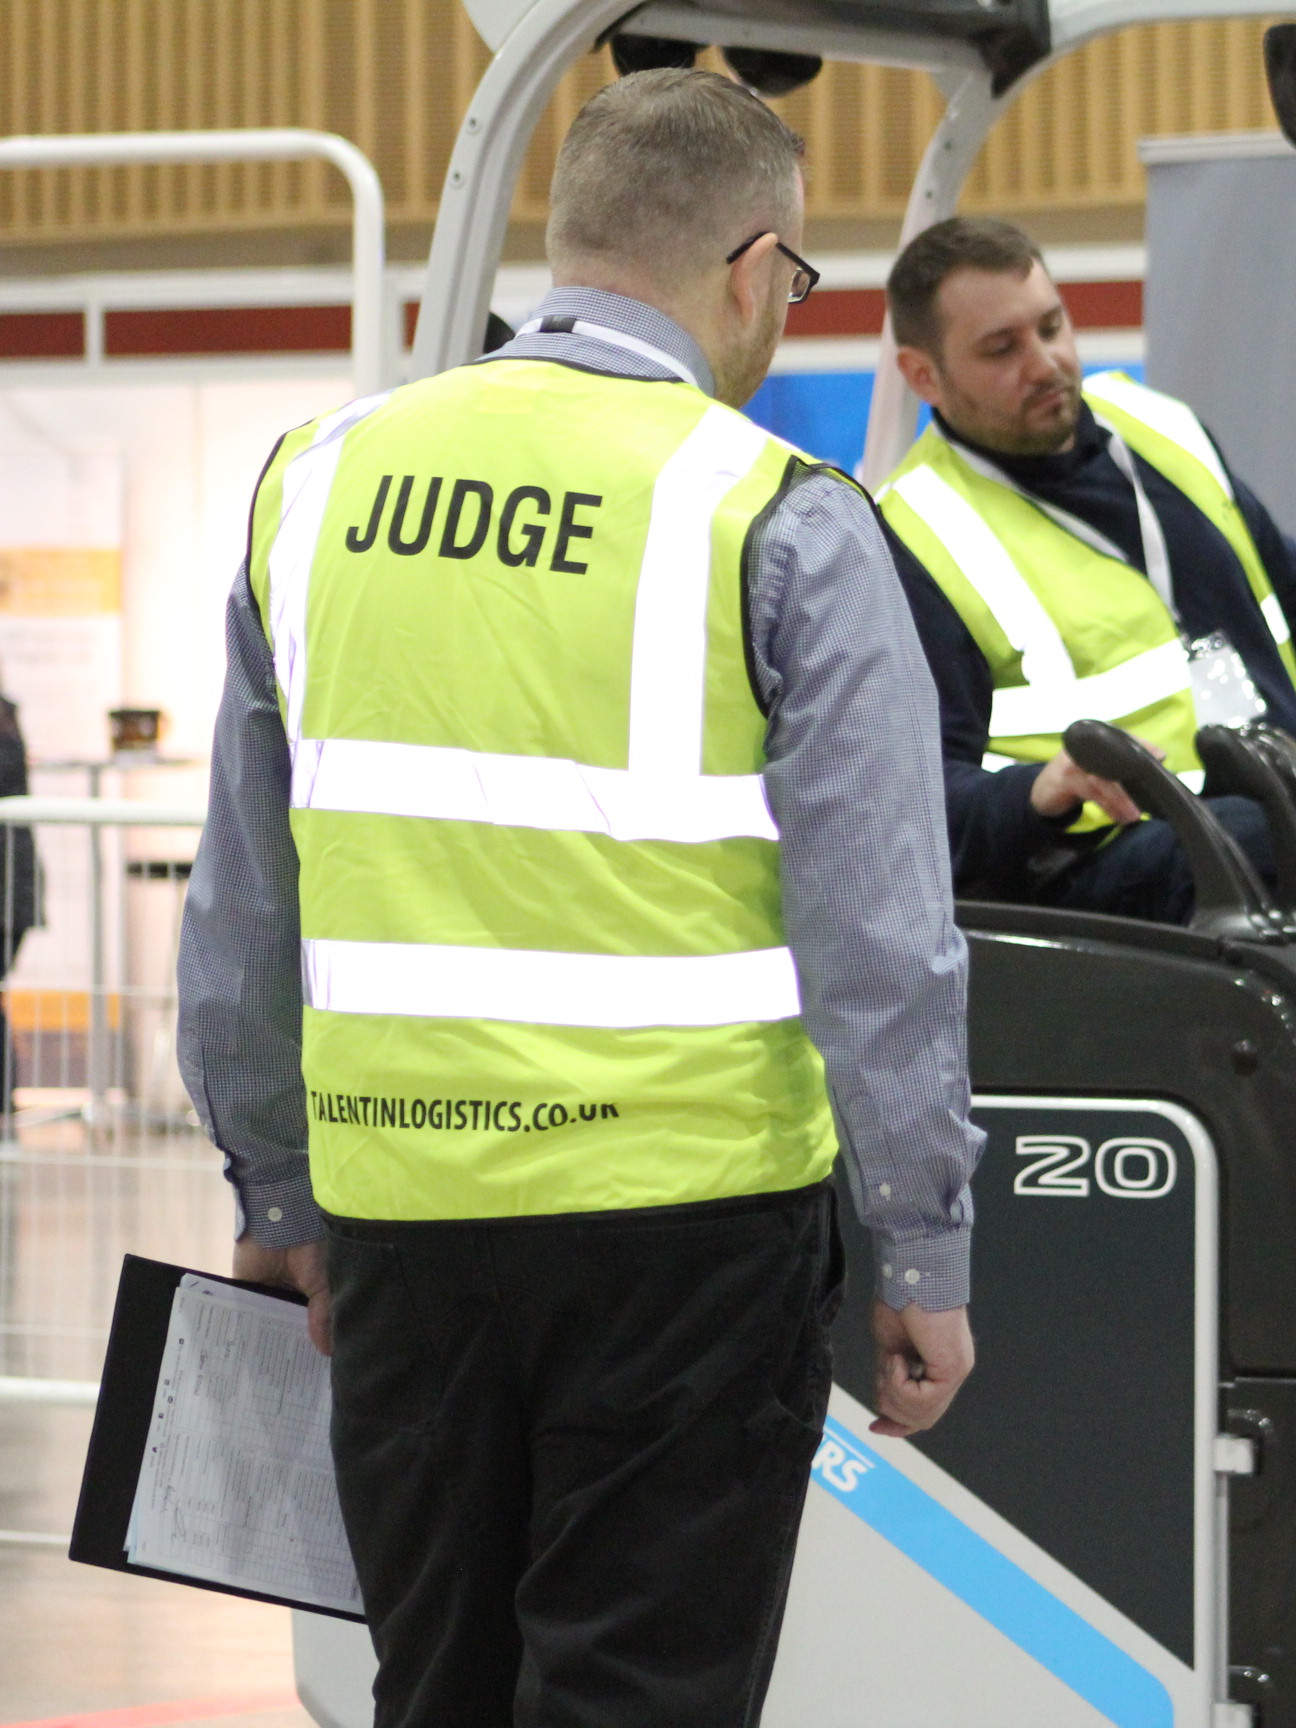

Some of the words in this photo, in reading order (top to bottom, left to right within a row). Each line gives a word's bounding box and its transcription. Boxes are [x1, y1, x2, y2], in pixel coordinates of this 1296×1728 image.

[345, 475, 603, 575] JUDGE
[1014, 1134, 1178, 1199] 20
[811, 1436, 867, 1492] RS
